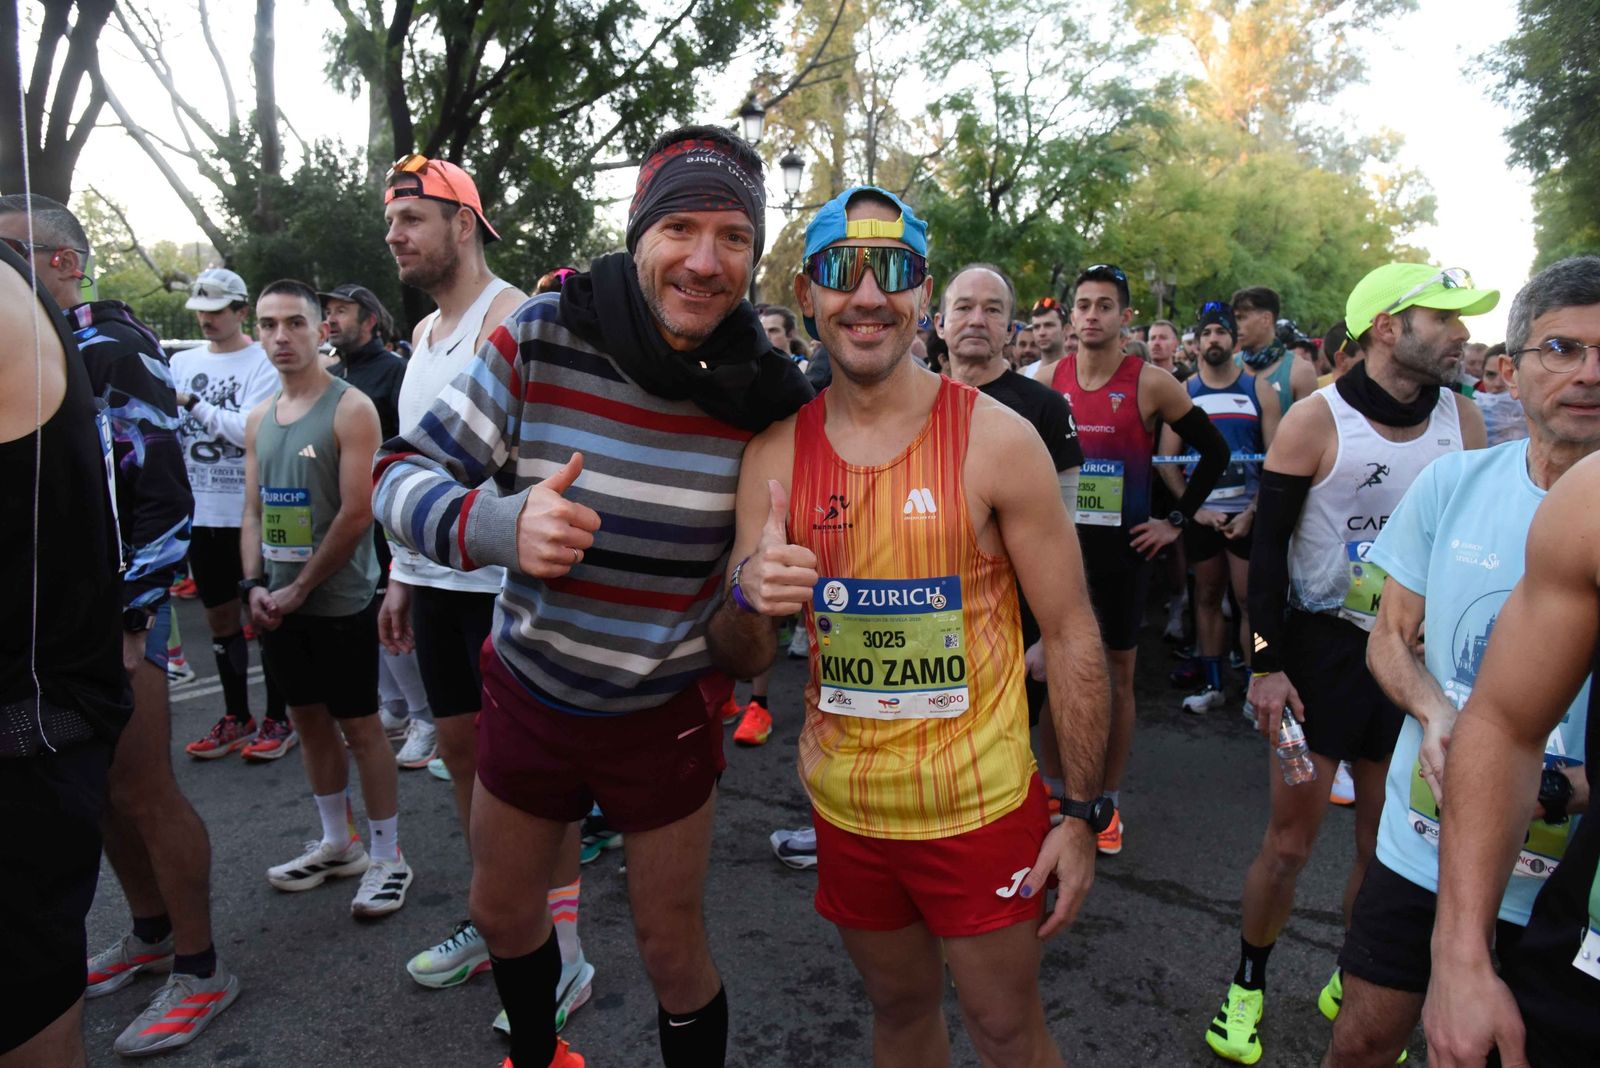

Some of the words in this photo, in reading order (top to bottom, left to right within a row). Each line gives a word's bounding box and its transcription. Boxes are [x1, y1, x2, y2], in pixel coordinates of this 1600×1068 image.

[857, 586, 941, 607] ZURICH
[862, 630, 906, 649] 3025
[821, 654, 874, 685] KIKO
[881, 655, 966, 686] ZAMO
